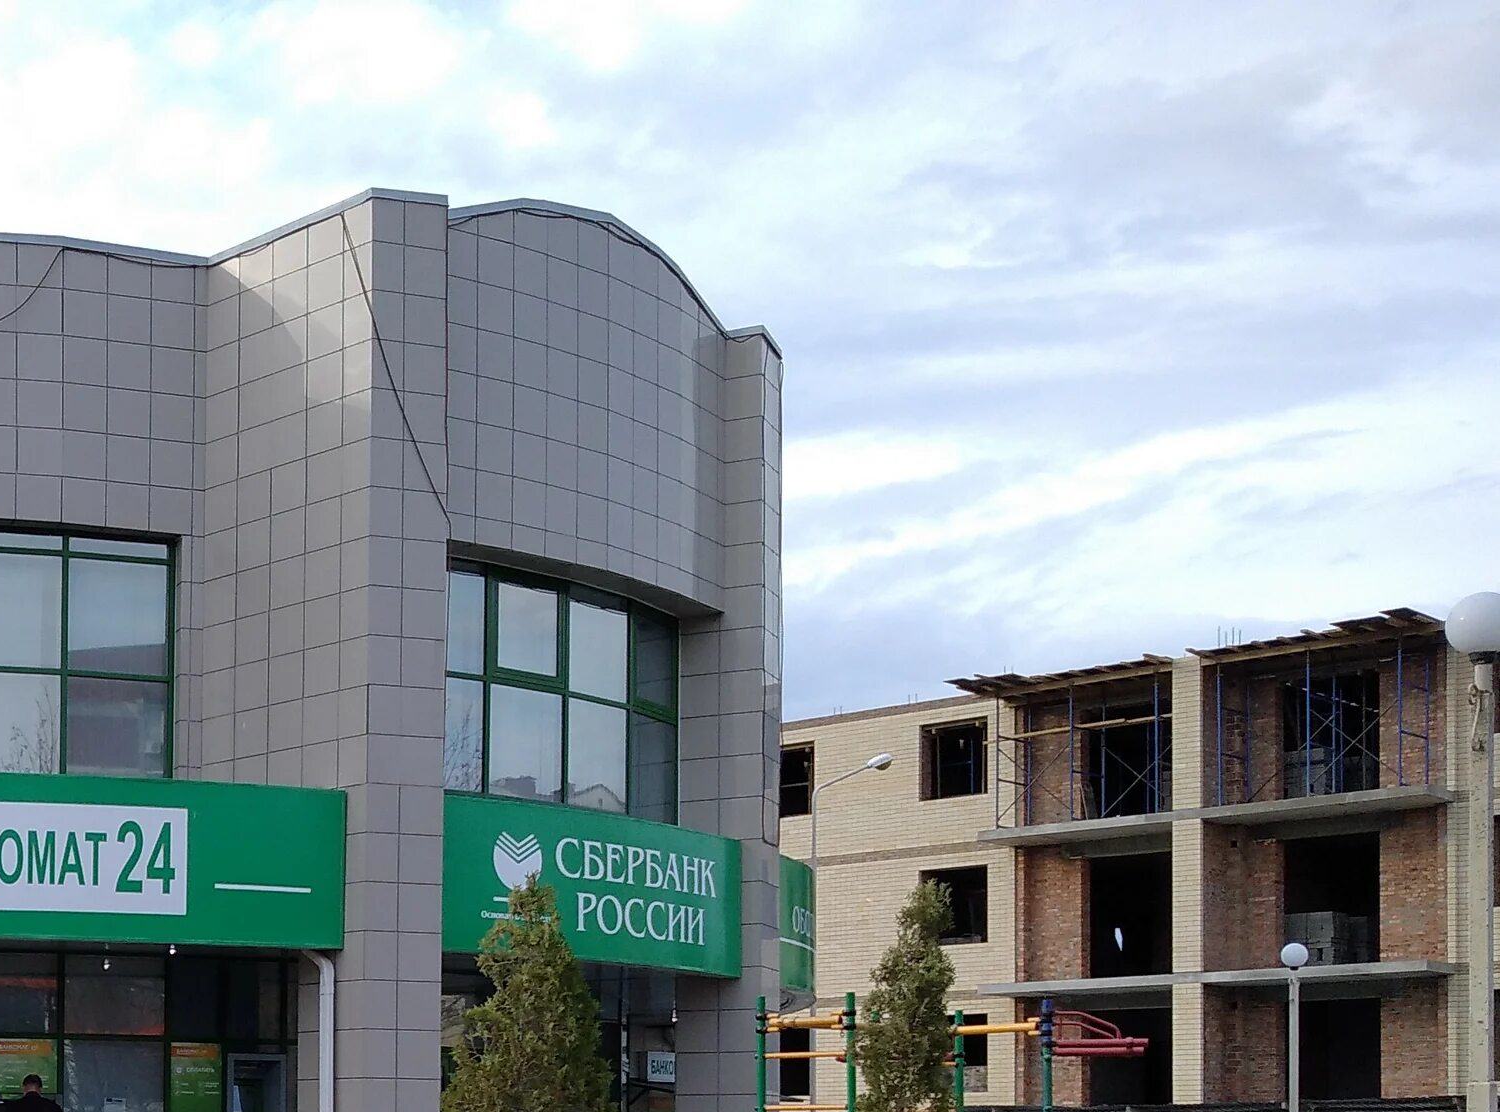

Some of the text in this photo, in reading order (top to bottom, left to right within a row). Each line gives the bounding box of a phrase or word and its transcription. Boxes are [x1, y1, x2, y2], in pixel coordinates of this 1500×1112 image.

[115, 819, 177, 895] 24
[555, 837, 717, 898] СБЕРБАНК
[576, 892, 705, 946] РОССИИ
